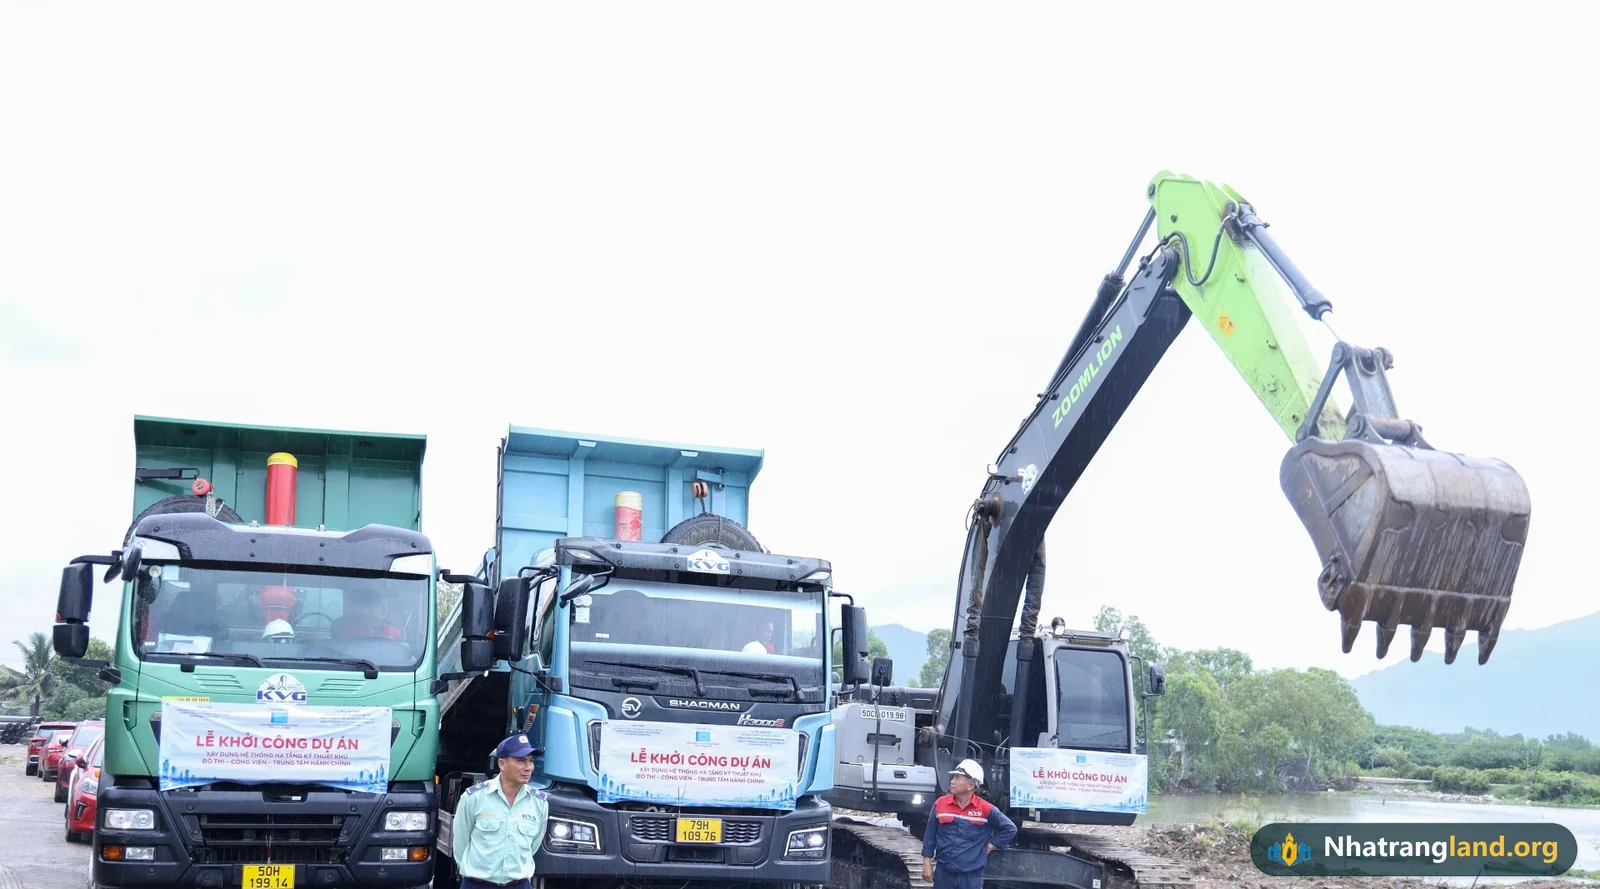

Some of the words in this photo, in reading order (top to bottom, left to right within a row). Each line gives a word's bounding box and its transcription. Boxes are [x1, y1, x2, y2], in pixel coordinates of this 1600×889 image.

[1052, 324, 1123, 430] ZOOMLION
[688, 560, 729, 570] KVG
[257, 690, 306, 700] KVG
[669, 700, 740, 710] SHACMAN
[196, 730, 215, 747] LỄ
[219, 732, 258, 748] KHỞI
[262, 734, 308, 749] CÔNG
[312, 737, 334, 752] DỰ
[336, 736, 358, 750] ÁN
[630, 748, 647, 763] LỄ
[650, 750, 684, 765] KHỞI
[688, 753, 727, 767] CÔNG
[731, 756, 750, 771] DỰ
[752, 755, 770, 769] ÁN
[1032, 766, 1045, 778] LỄ
[1048, 768, 1070, 779] KHỞI
[1072, 770, 1098, 781] CÔNG
[1100, 774, 1113, 785] DỰ
[1114, 773, 1127, 783] ÁN
[690, 820, 708, 830] 79H
[683, 831, 716, 841] 109.76
[258, 866, 280, 876] 50H
[250, 878, 288, 888] 199.14
